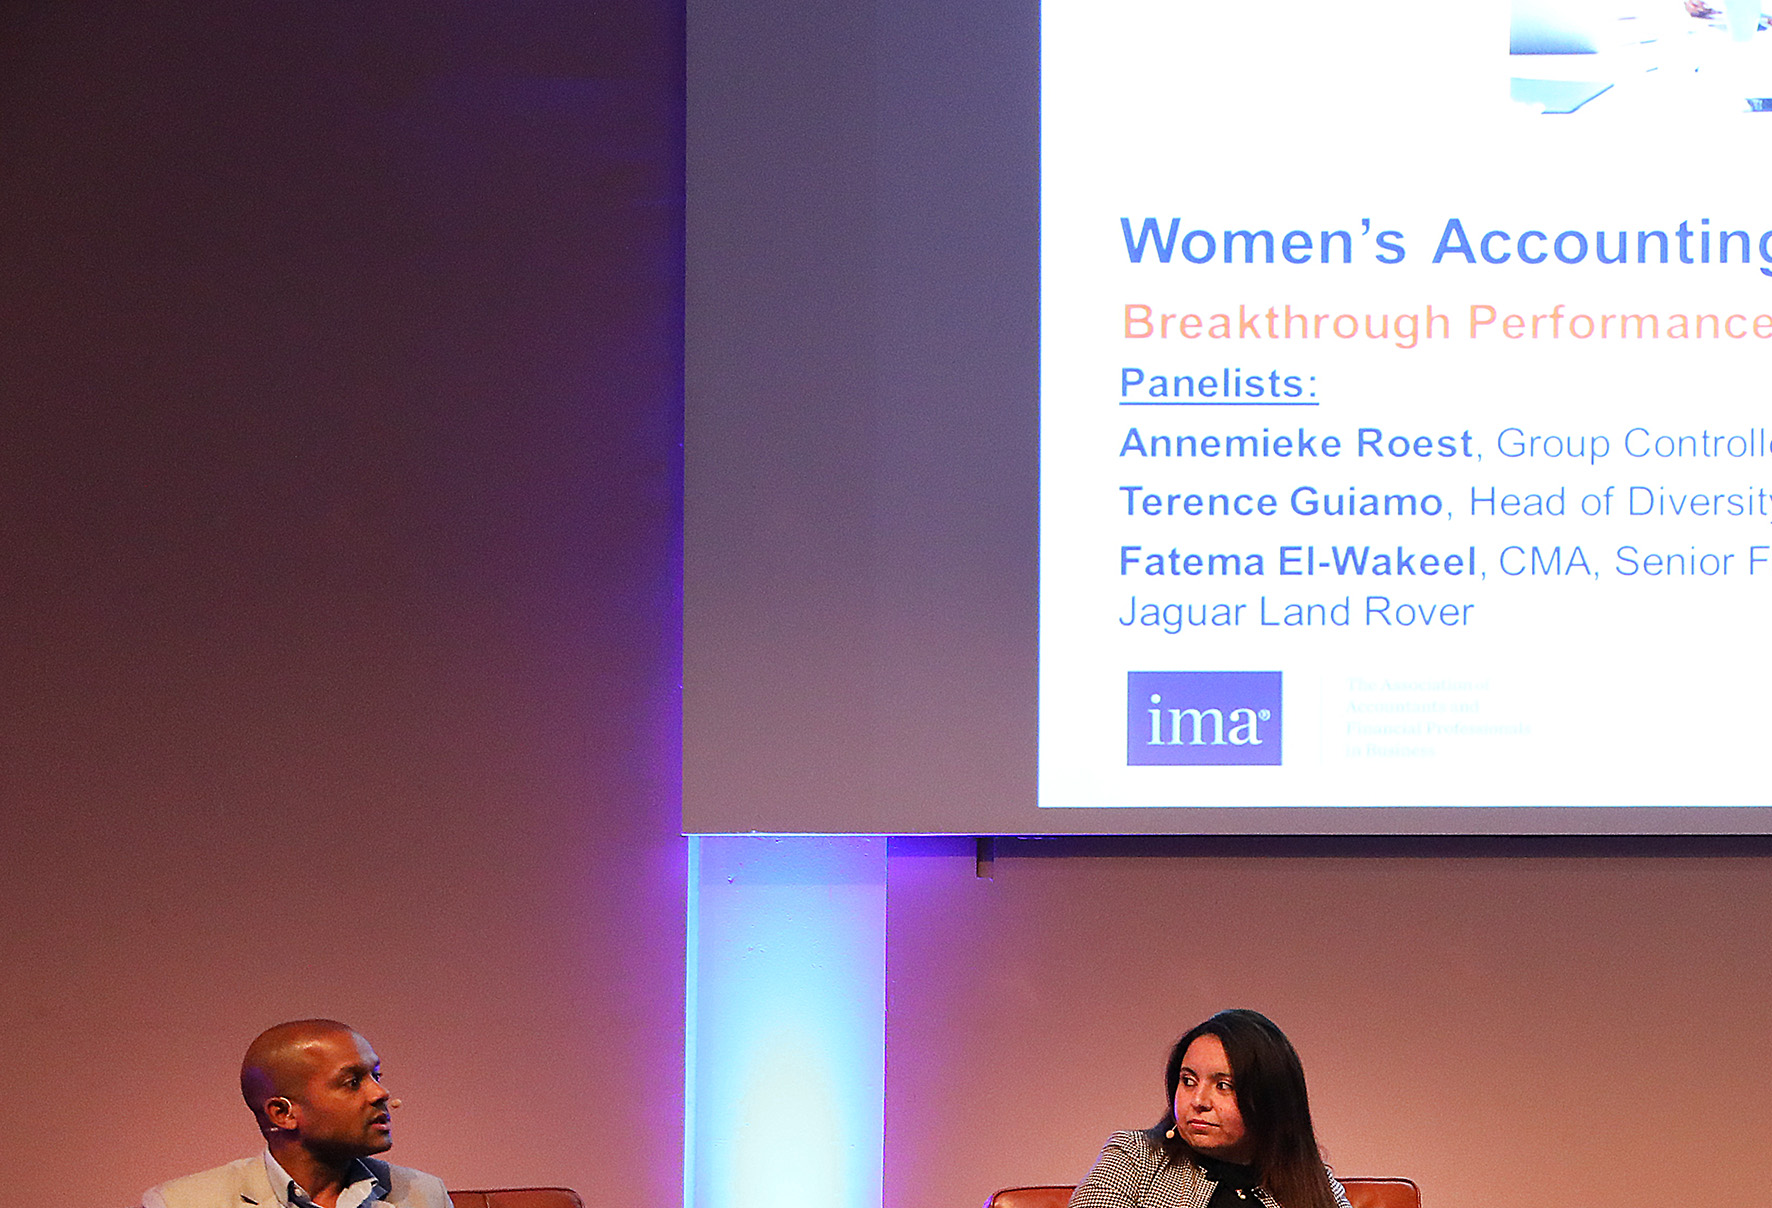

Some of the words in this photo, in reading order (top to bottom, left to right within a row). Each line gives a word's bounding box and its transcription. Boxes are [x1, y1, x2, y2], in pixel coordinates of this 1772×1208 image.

[1123, 303, 1450, 350] Breakthrough
[1121, 366, 1317, 402] Panelists:
[1119, 426, 1342, 458] Annemieke
[1357, 426, 1483, 463] Roest,
[1497, 426, 1611, 466] Group
[1119, 485, 1279, 517] Terence
[1290, 485, 1453, 522] Guiamo,
[1470, 485, 1566, 517] Head
[1580, 485, 1616, 517] of
[1120, 545, 1265, 577] Fatema
[1279, 544, 1487, 582] El-Wakeel,
[1499, 544, 1600, 581] CMA,
[1615, 544, 1736, 577] Senior
[1118, 594, 1248, 635] Jaguar
[1260, 595, 1351, 627] Land
[1365, 594, 1476, 627] Rover
